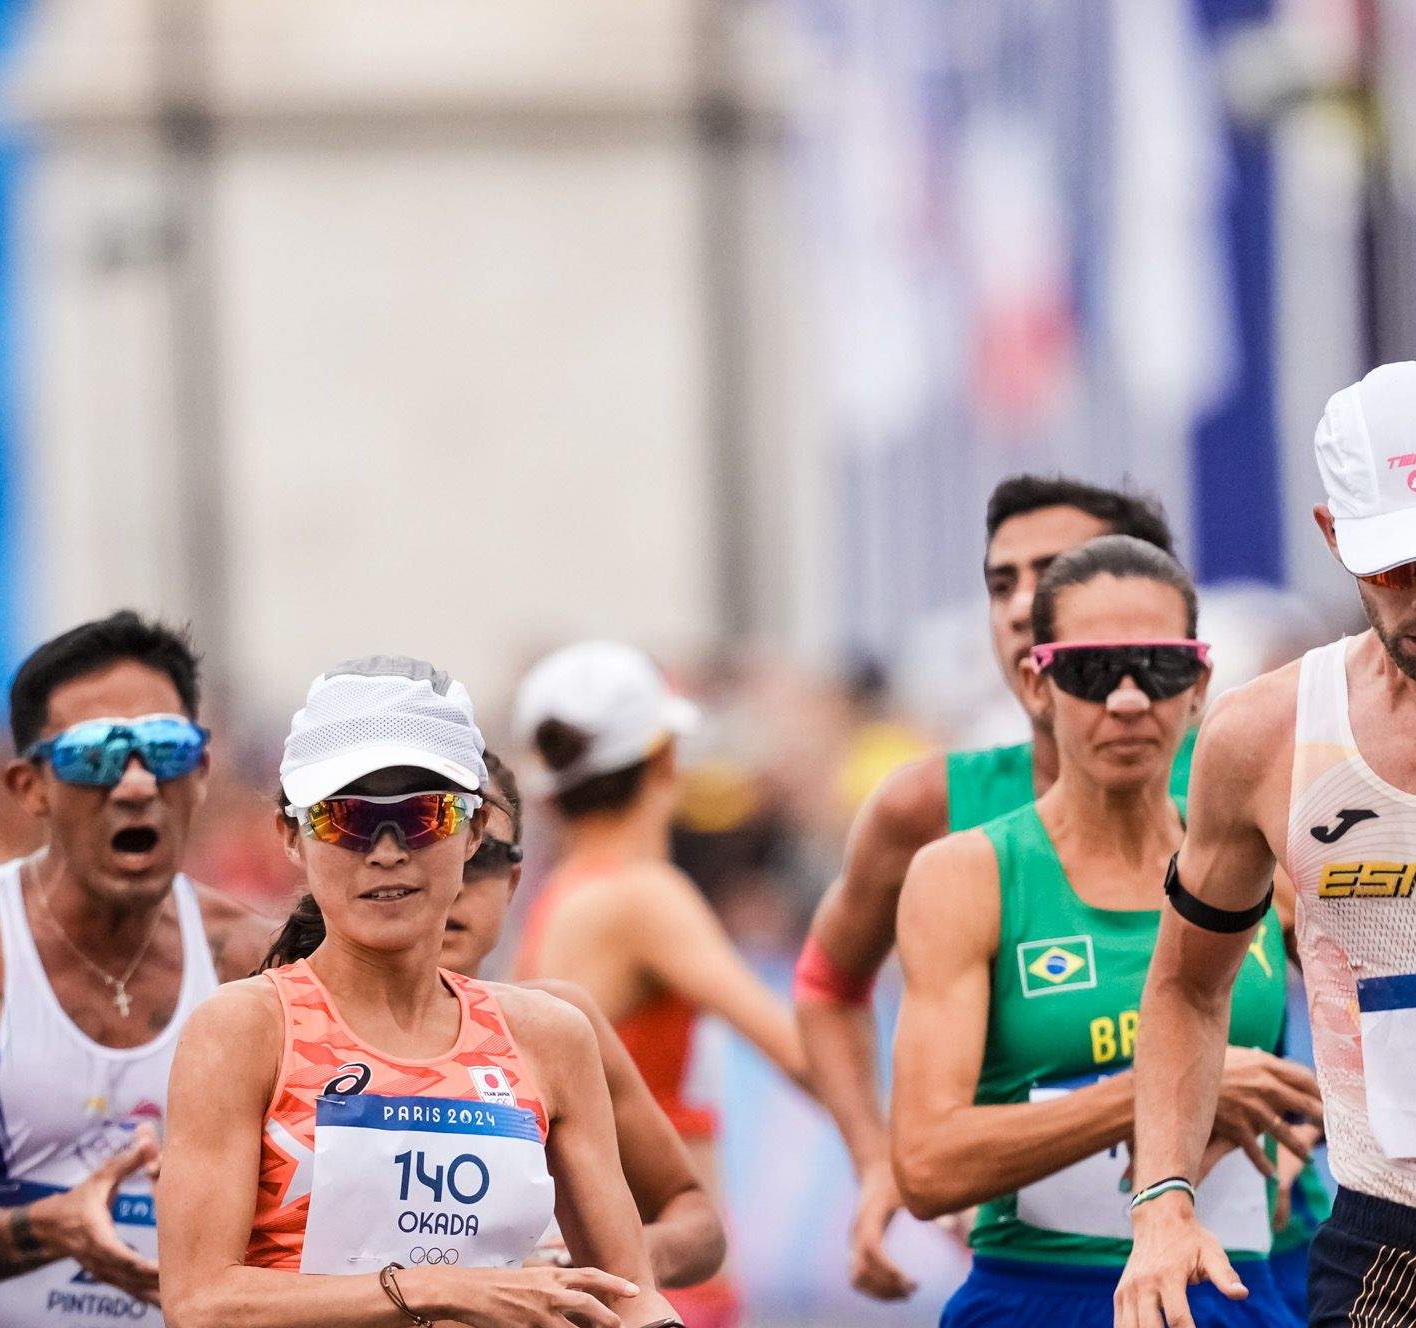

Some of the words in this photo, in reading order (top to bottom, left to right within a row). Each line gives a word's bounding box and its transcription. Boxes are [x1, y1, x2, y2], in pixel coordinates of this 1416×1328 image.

[383, 1106, 441, 1123] PARIS
[448, 1108, 496, 1127] 2024
[394, 1150, 490, 1205] 140
[397, 1210, 480, 1237] OKADA
[46, 1288, 149, 1319] PINTADO
